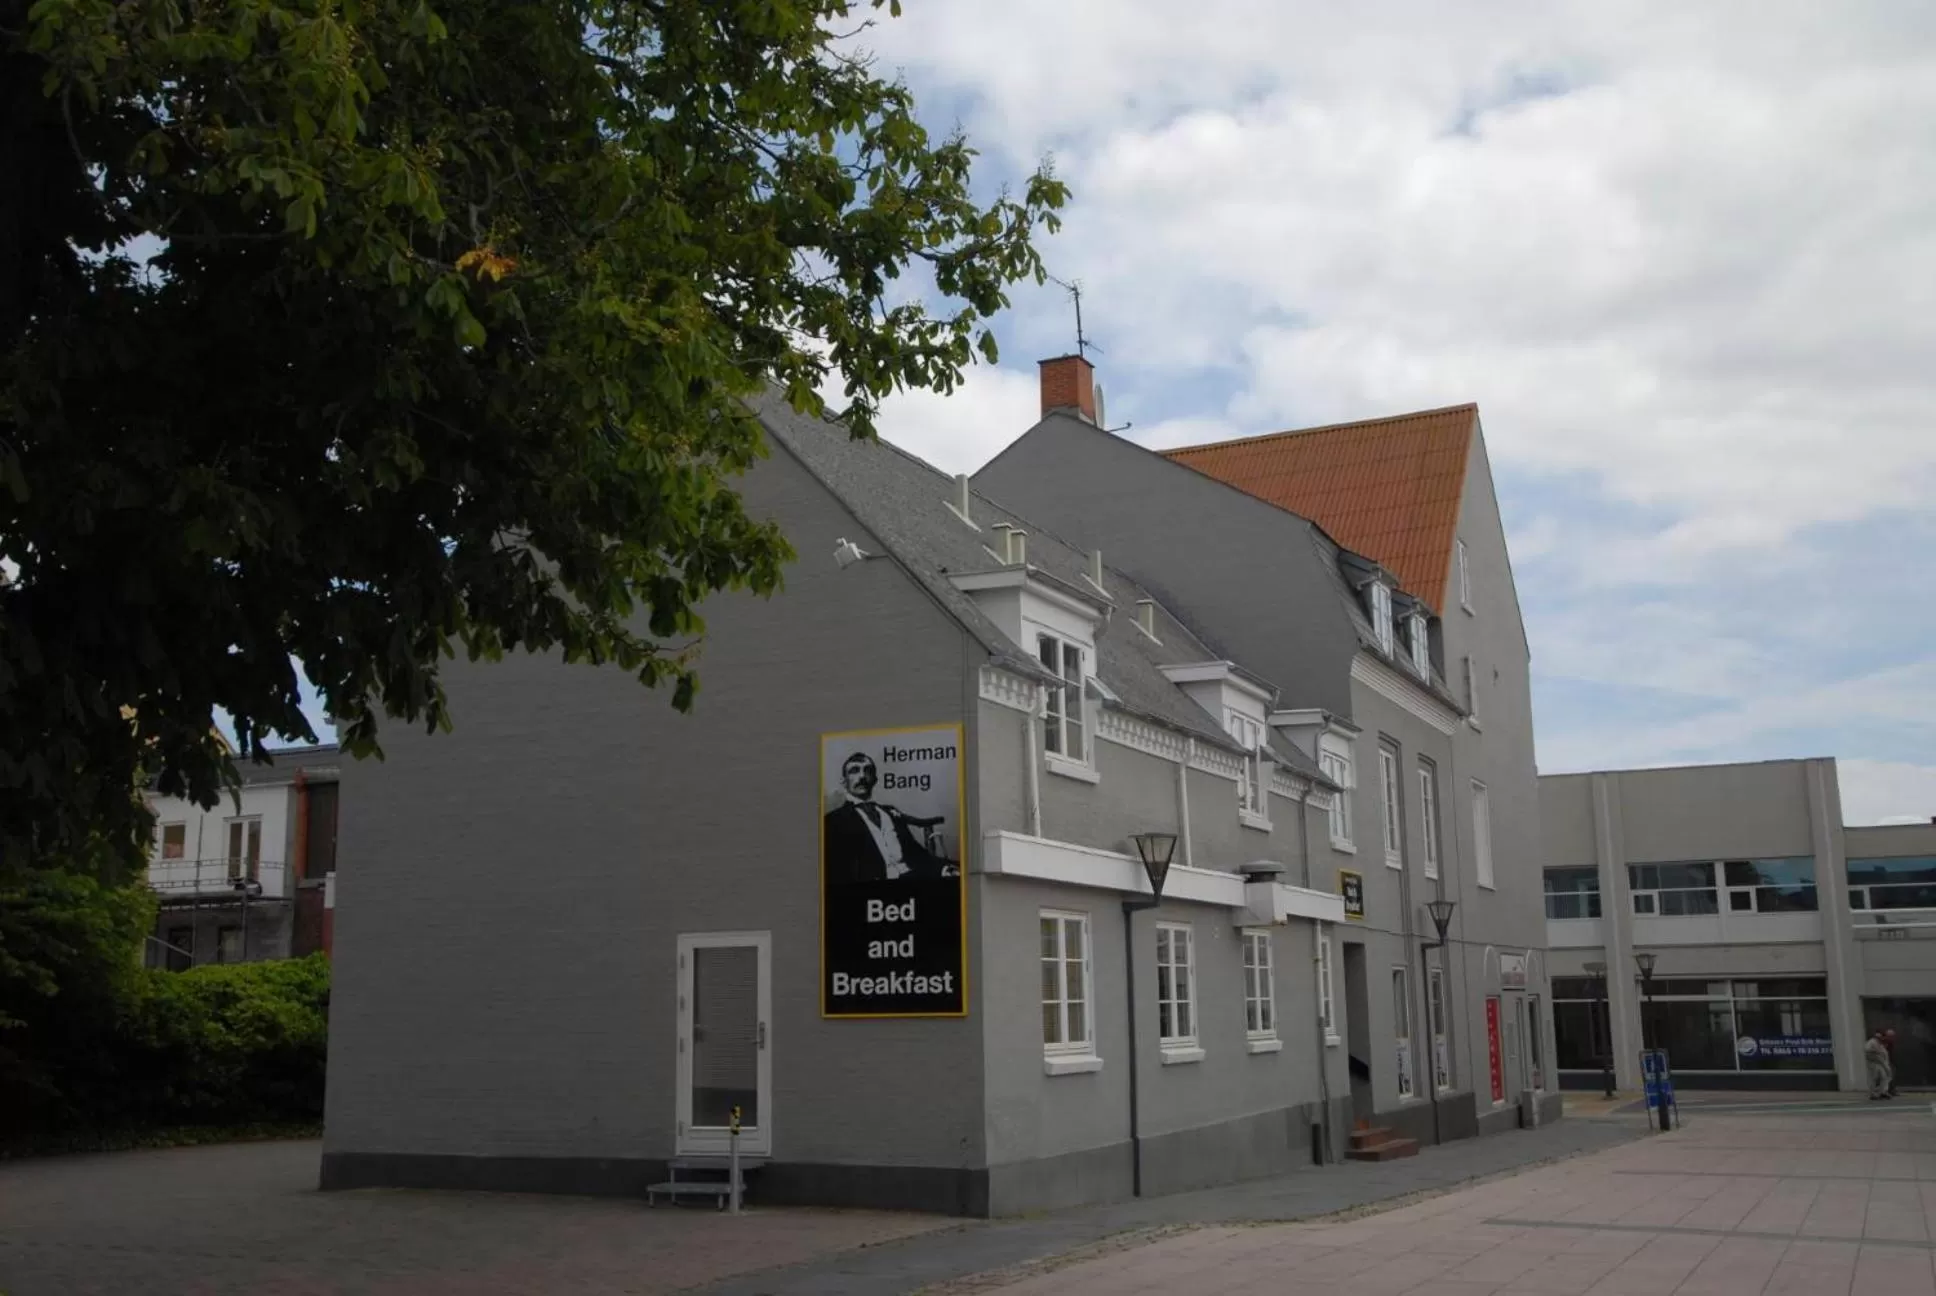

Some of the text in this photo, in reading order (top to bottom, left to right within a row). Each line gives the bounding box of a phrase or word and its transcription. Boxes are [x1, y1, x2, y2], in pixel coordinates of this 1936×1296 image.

[883, 745, 957, 763] Herman
[883, 772, 932, 792] Bang
[866, 897, 916, 923] Bed
[867, 933, 915, 959] and
[832, 970, 954, 996] Breakfast
